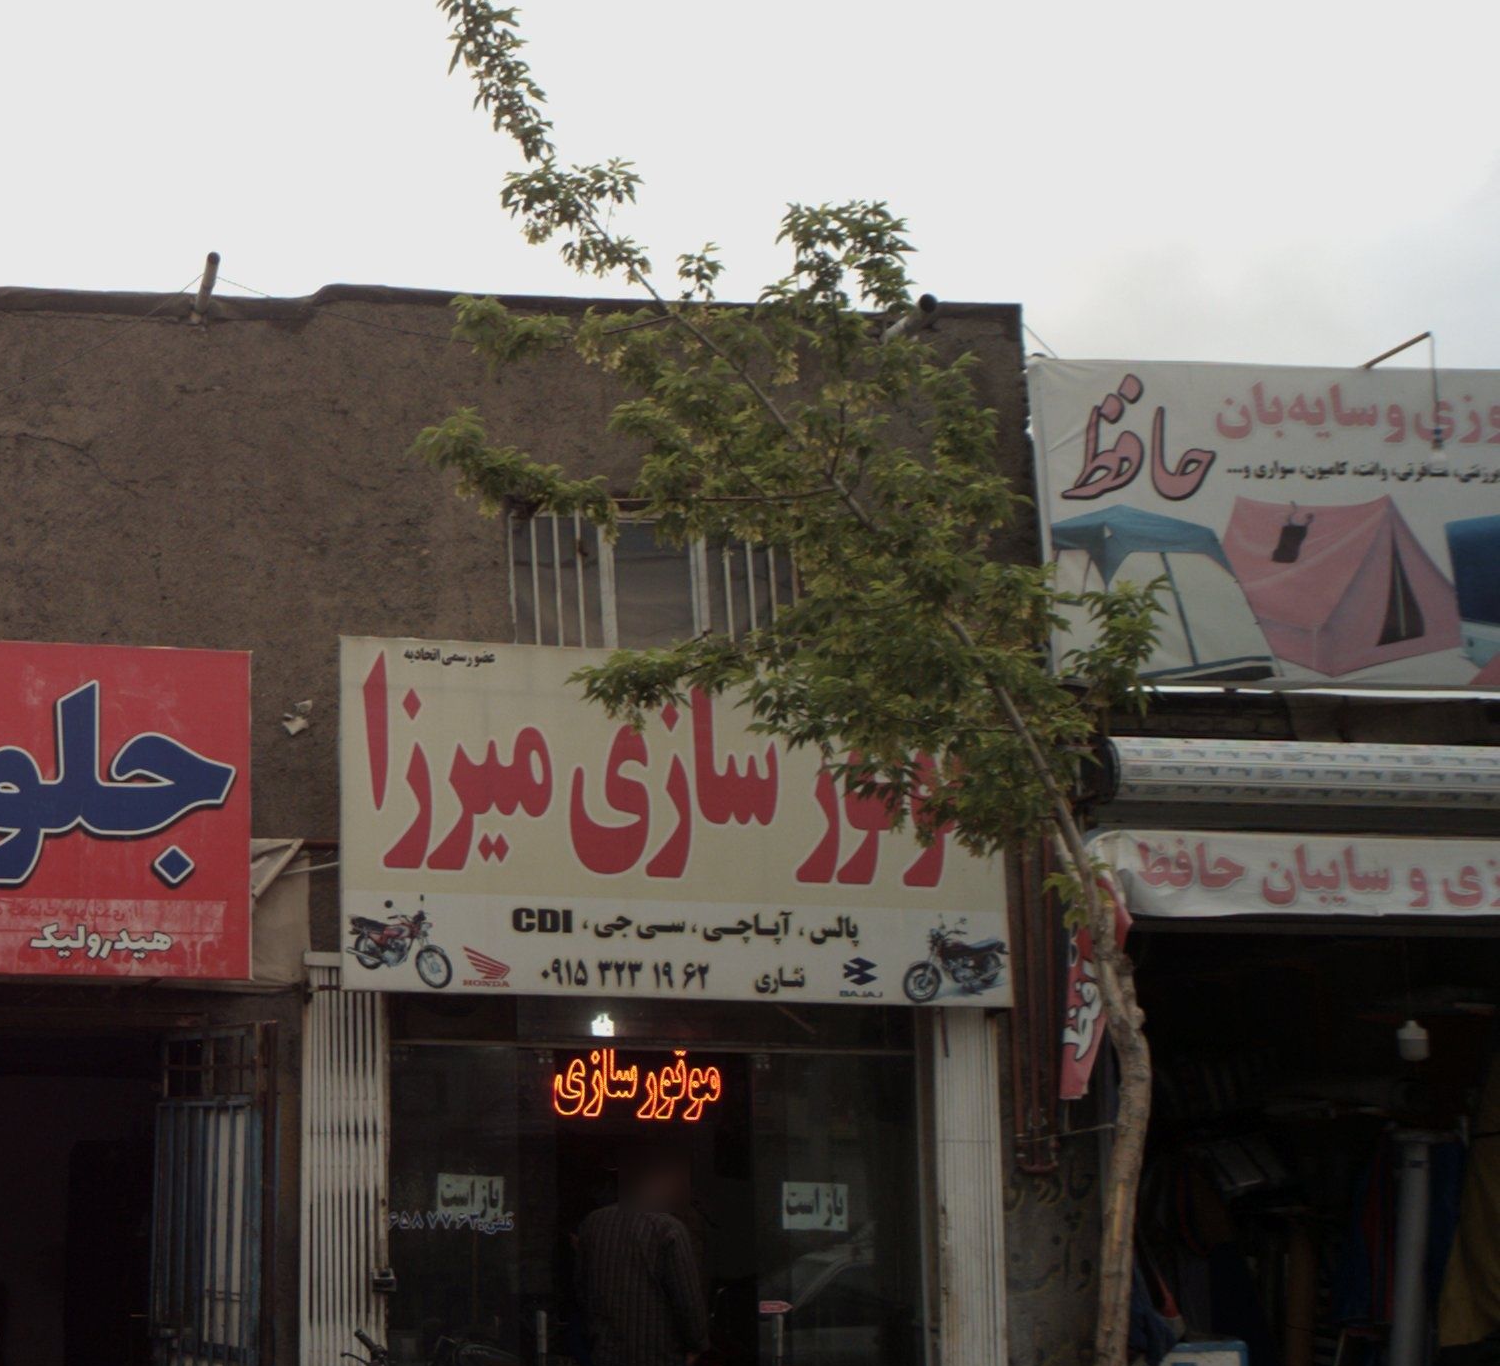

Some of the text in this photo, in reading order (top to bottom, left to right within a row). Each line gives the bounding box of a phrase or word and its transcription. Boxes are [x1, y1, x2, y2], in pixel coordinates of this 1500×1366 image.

[1061, 373, 1216, 501] حافظ
[362, 650, 966, 887] وور سازی میرزا
[1135, 837, 1246, 888] حافظ
[1261, 842, 1391, 906] سایبان
[30, 924, 174, 960] هیدرولیک
[512, 907, 573, 934] CDI
[462, 979, 510, 988] HONDA
[540, 958, 588, 988] ۰۹۱۵
[553, 1048, 721, 1121] موتور سازی
